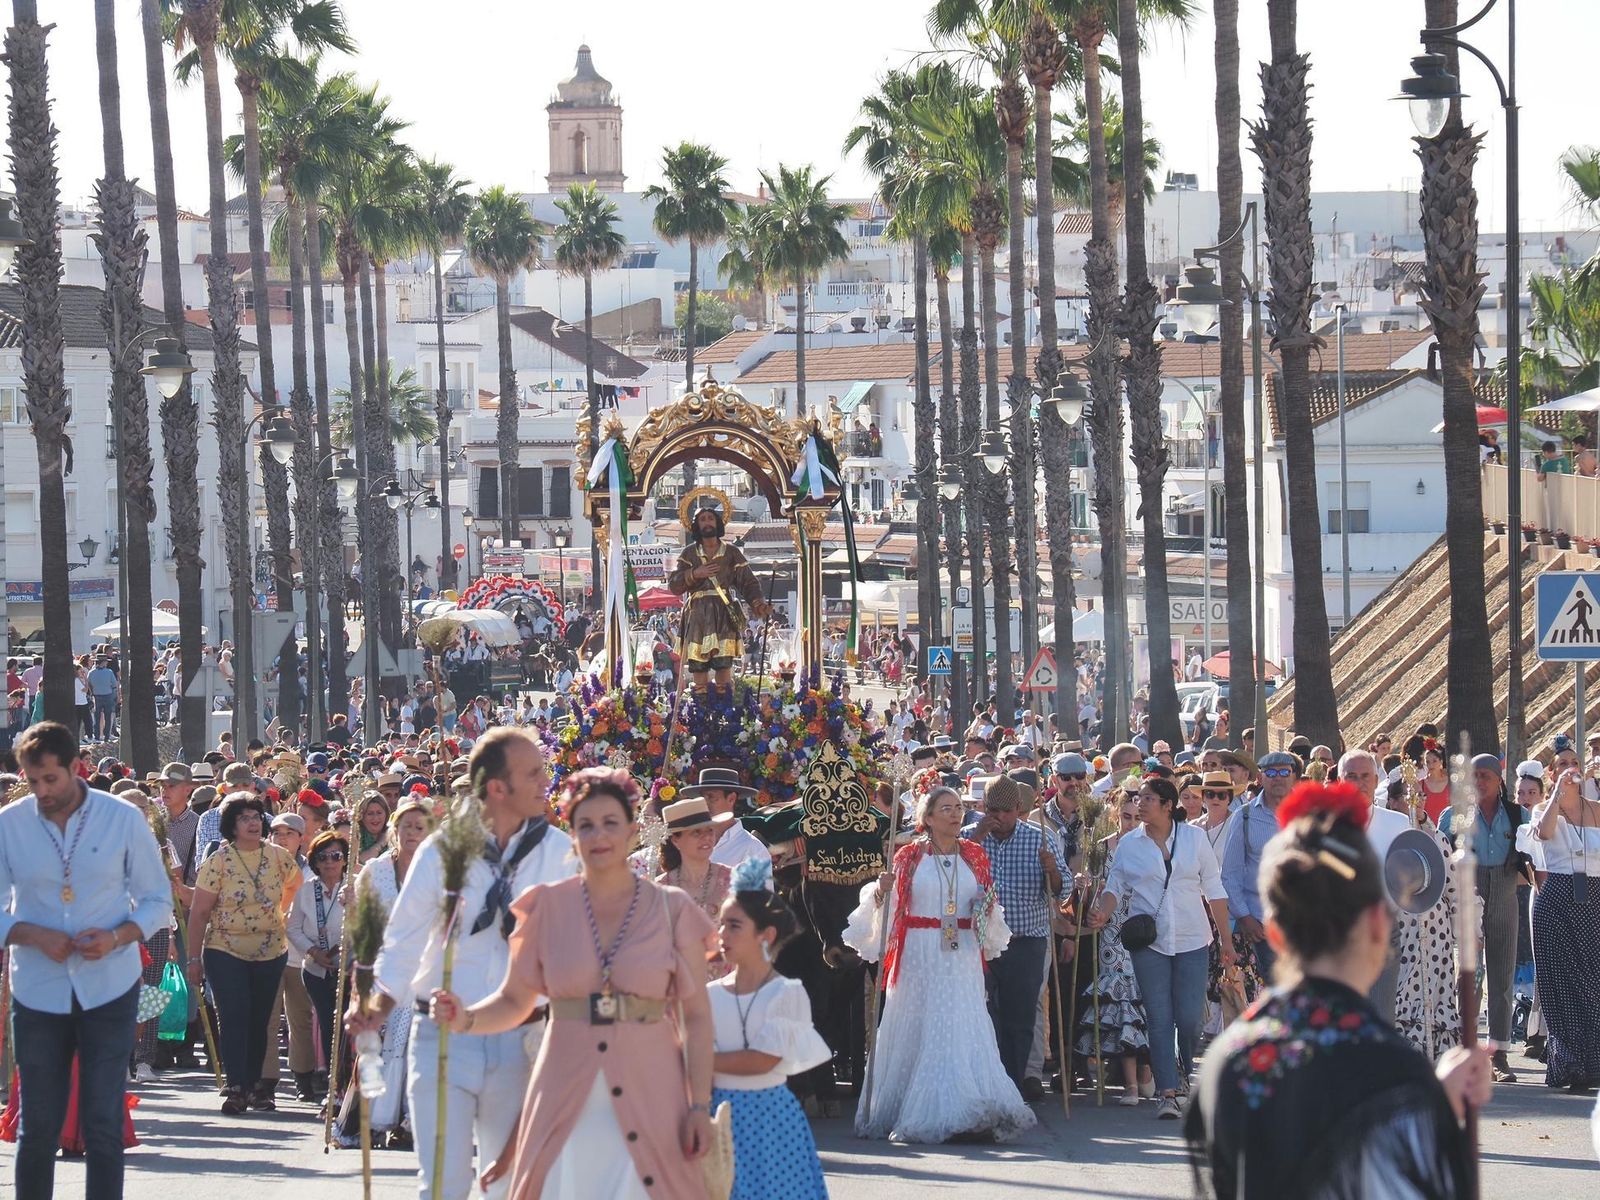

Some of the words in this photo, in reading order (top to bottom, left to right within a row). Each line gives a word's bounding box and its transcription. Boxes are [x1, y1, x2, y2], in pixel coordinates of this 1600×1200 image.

[1172, 602, 1228, 620] SAO
[817, 849, 837, 865] San
[837, 846, 875, 865] Isidro
